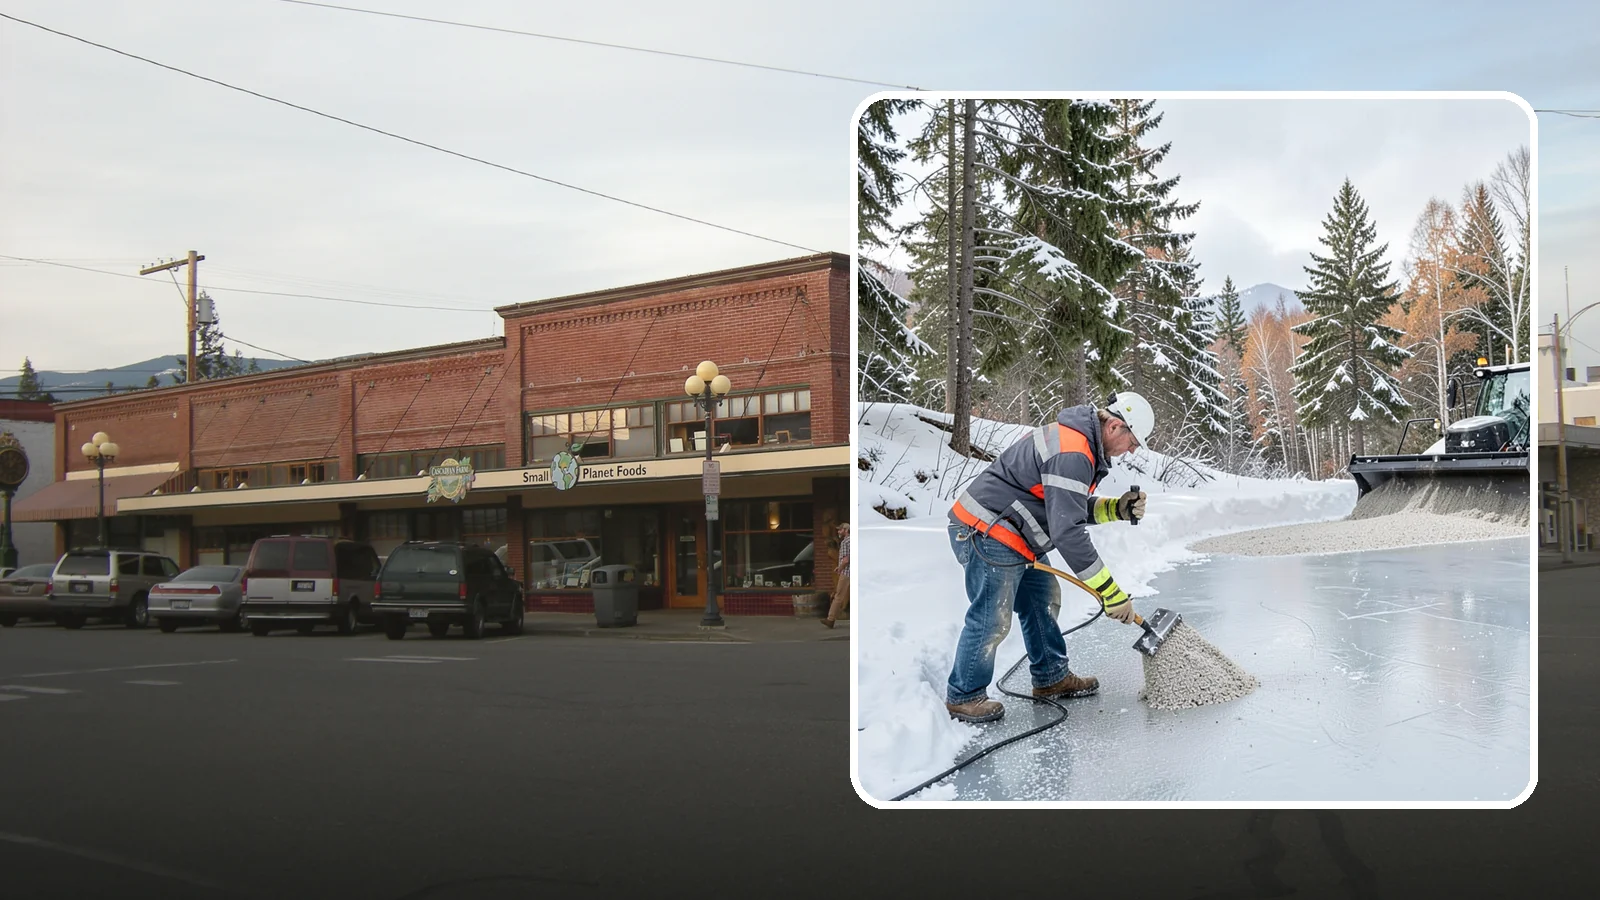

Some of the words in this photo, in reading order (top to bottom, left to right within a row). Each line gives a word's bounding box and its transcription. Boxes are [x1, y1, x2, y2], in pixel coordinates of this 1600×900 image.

[523, 471, 549, 483] Small
[583, 467, 614, 479] Planet
[617, 464, 647, 477] Foods
